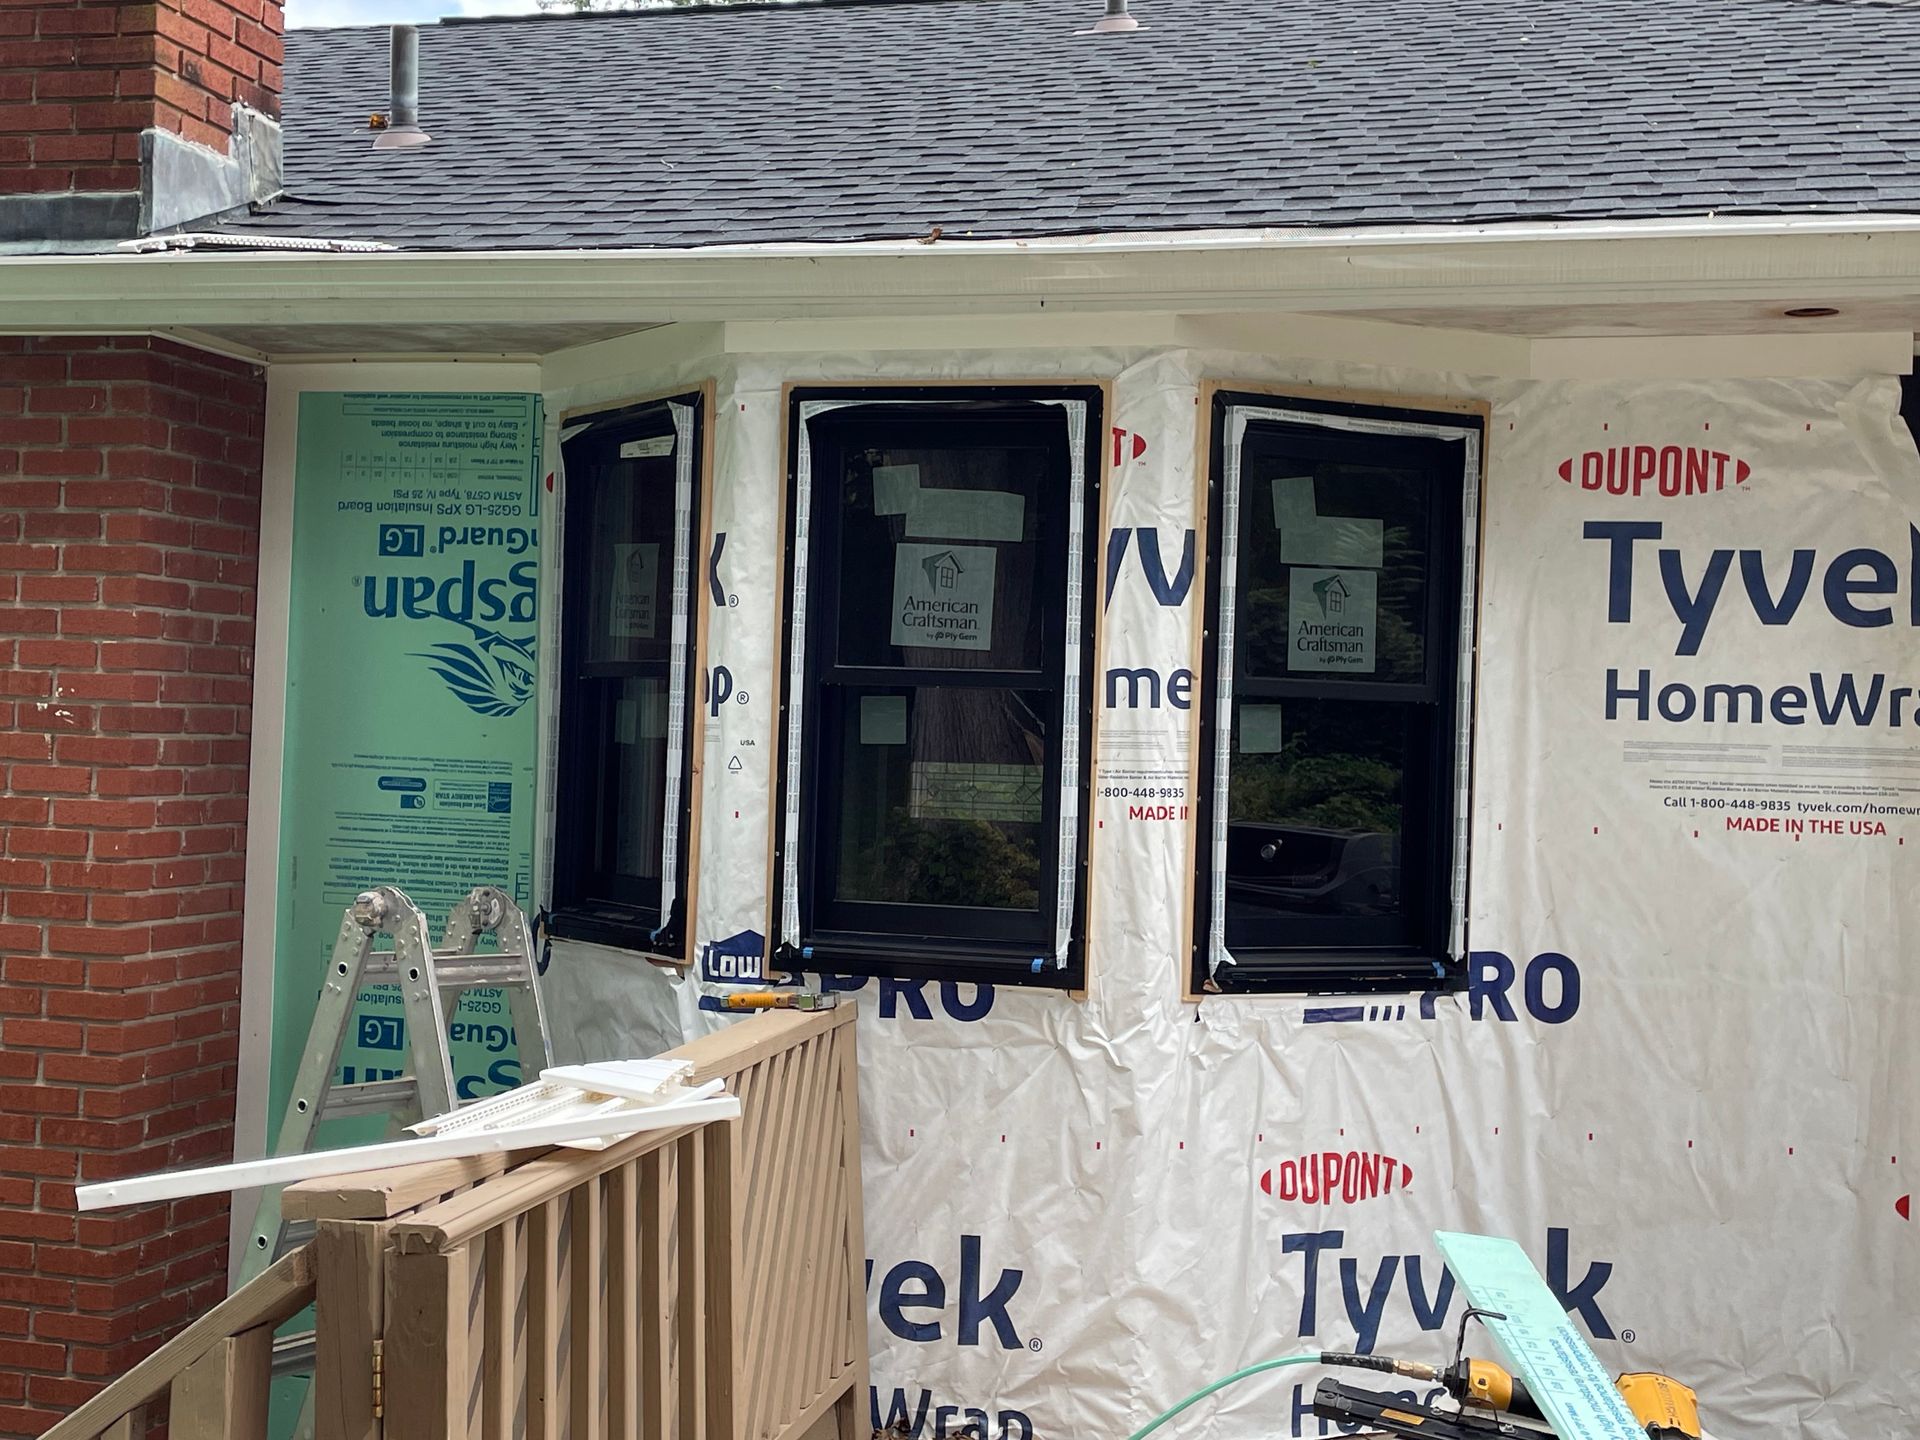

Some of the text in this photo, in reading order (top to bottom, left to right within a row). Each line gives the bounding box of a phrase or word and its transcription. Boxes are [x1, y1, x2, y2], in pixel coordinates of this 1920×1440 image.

[499, 420, 518, 430] Easy
[381, 430, 518, 441] Strong resistance to compression
[398, 441, 518, 451] Very high moisture resistance
[1581, 445, 1731, 497] DUPONT
[393, 489, 409, 499] PSI
[412, 490, 423, 499] 25
[439, 489, 461, 500] Type
[463, 489, 491, 500] C578,
[494, 491, 522, 501] ASTM
[338, 501, 521, 516] GG25-LG XPS Insulation Board
[385, 527, 419, 553] LG
[903, 595, 978, 614] American
[902, 612, 978, 630] Craftsman
[1297, 620, 1364, 637] American
[1297, 636, 1364, 652] Craftsman
[1663, 796, 1686, 808] Call
[1690, 797, 1791, 812] 1-800-448-9835
[1129, 805, 1175, 820] MADE
[1726, 816, 1887, 836] MADE IN THE USA
[356, 993, 404, 1006] sulation
[474, 988, 503, 998] ASTM
[457, 1001, 502, 1015] GG25-L
[364, 1019, 399, 1046] LG
[1280, 1150, 1399, 1205] DUPONT
[1282, 1227, 1617, 1354] Tyvk
